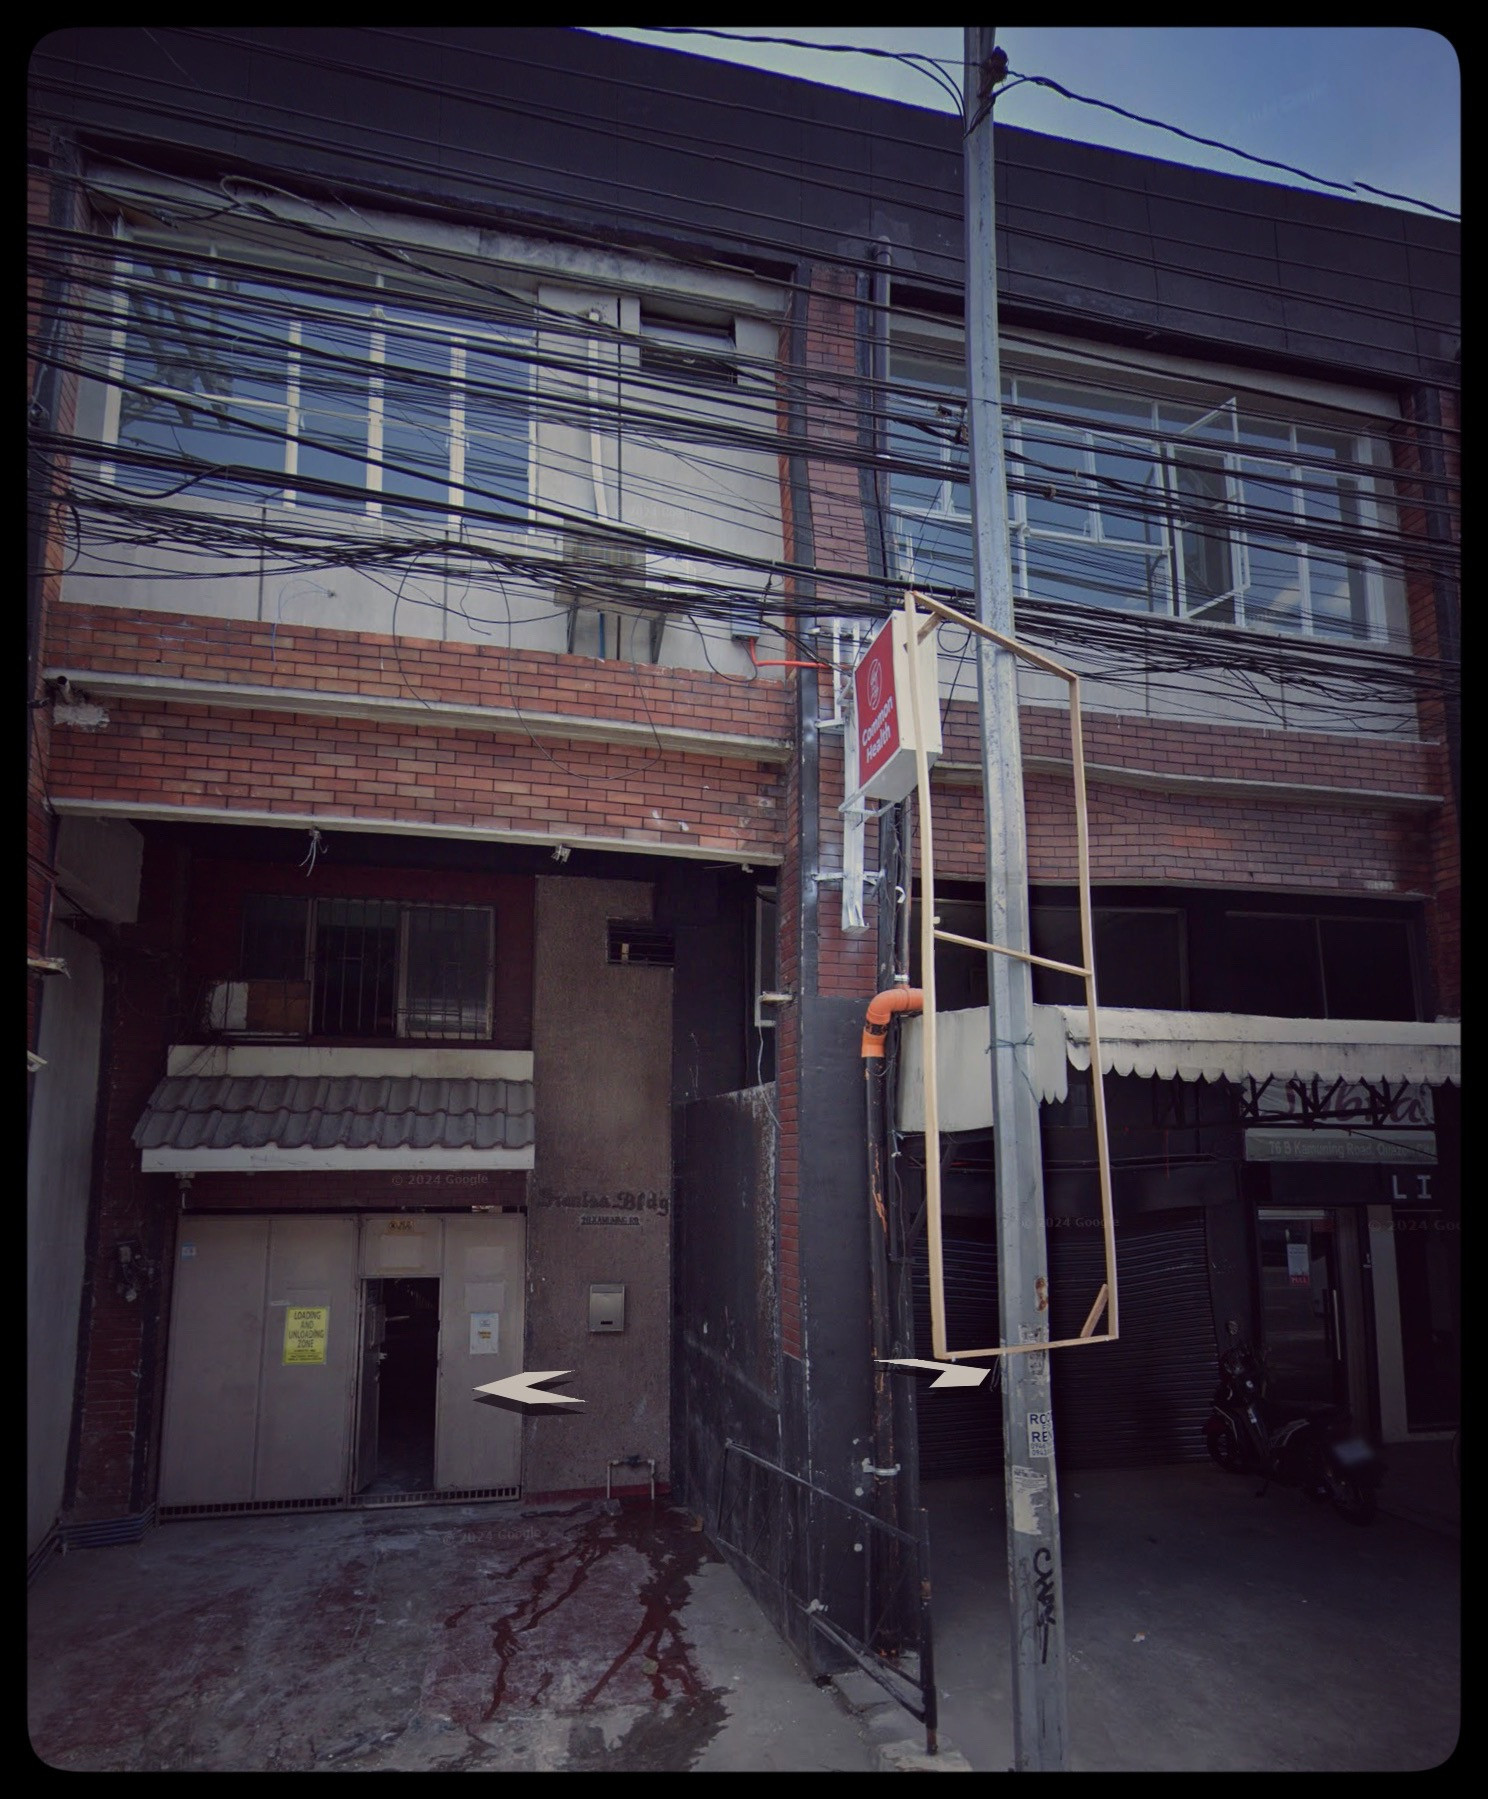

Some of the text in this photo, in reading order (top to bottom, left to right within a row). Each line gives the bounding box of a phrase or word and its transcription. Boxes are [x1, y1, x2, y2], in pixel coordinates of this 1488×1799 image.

[862, 696, 893, 746] Common
[866, 721, 891, 764] Health
[1294, 1141, 1345, 1158] Kamuning
[293, 1311, 321, 1320] LOADING
[300, 1320, 314, 1329] AND
[288, 1329, 324, 1339] UNLOADING
[297, 1339, 314, 1348] ZONE
